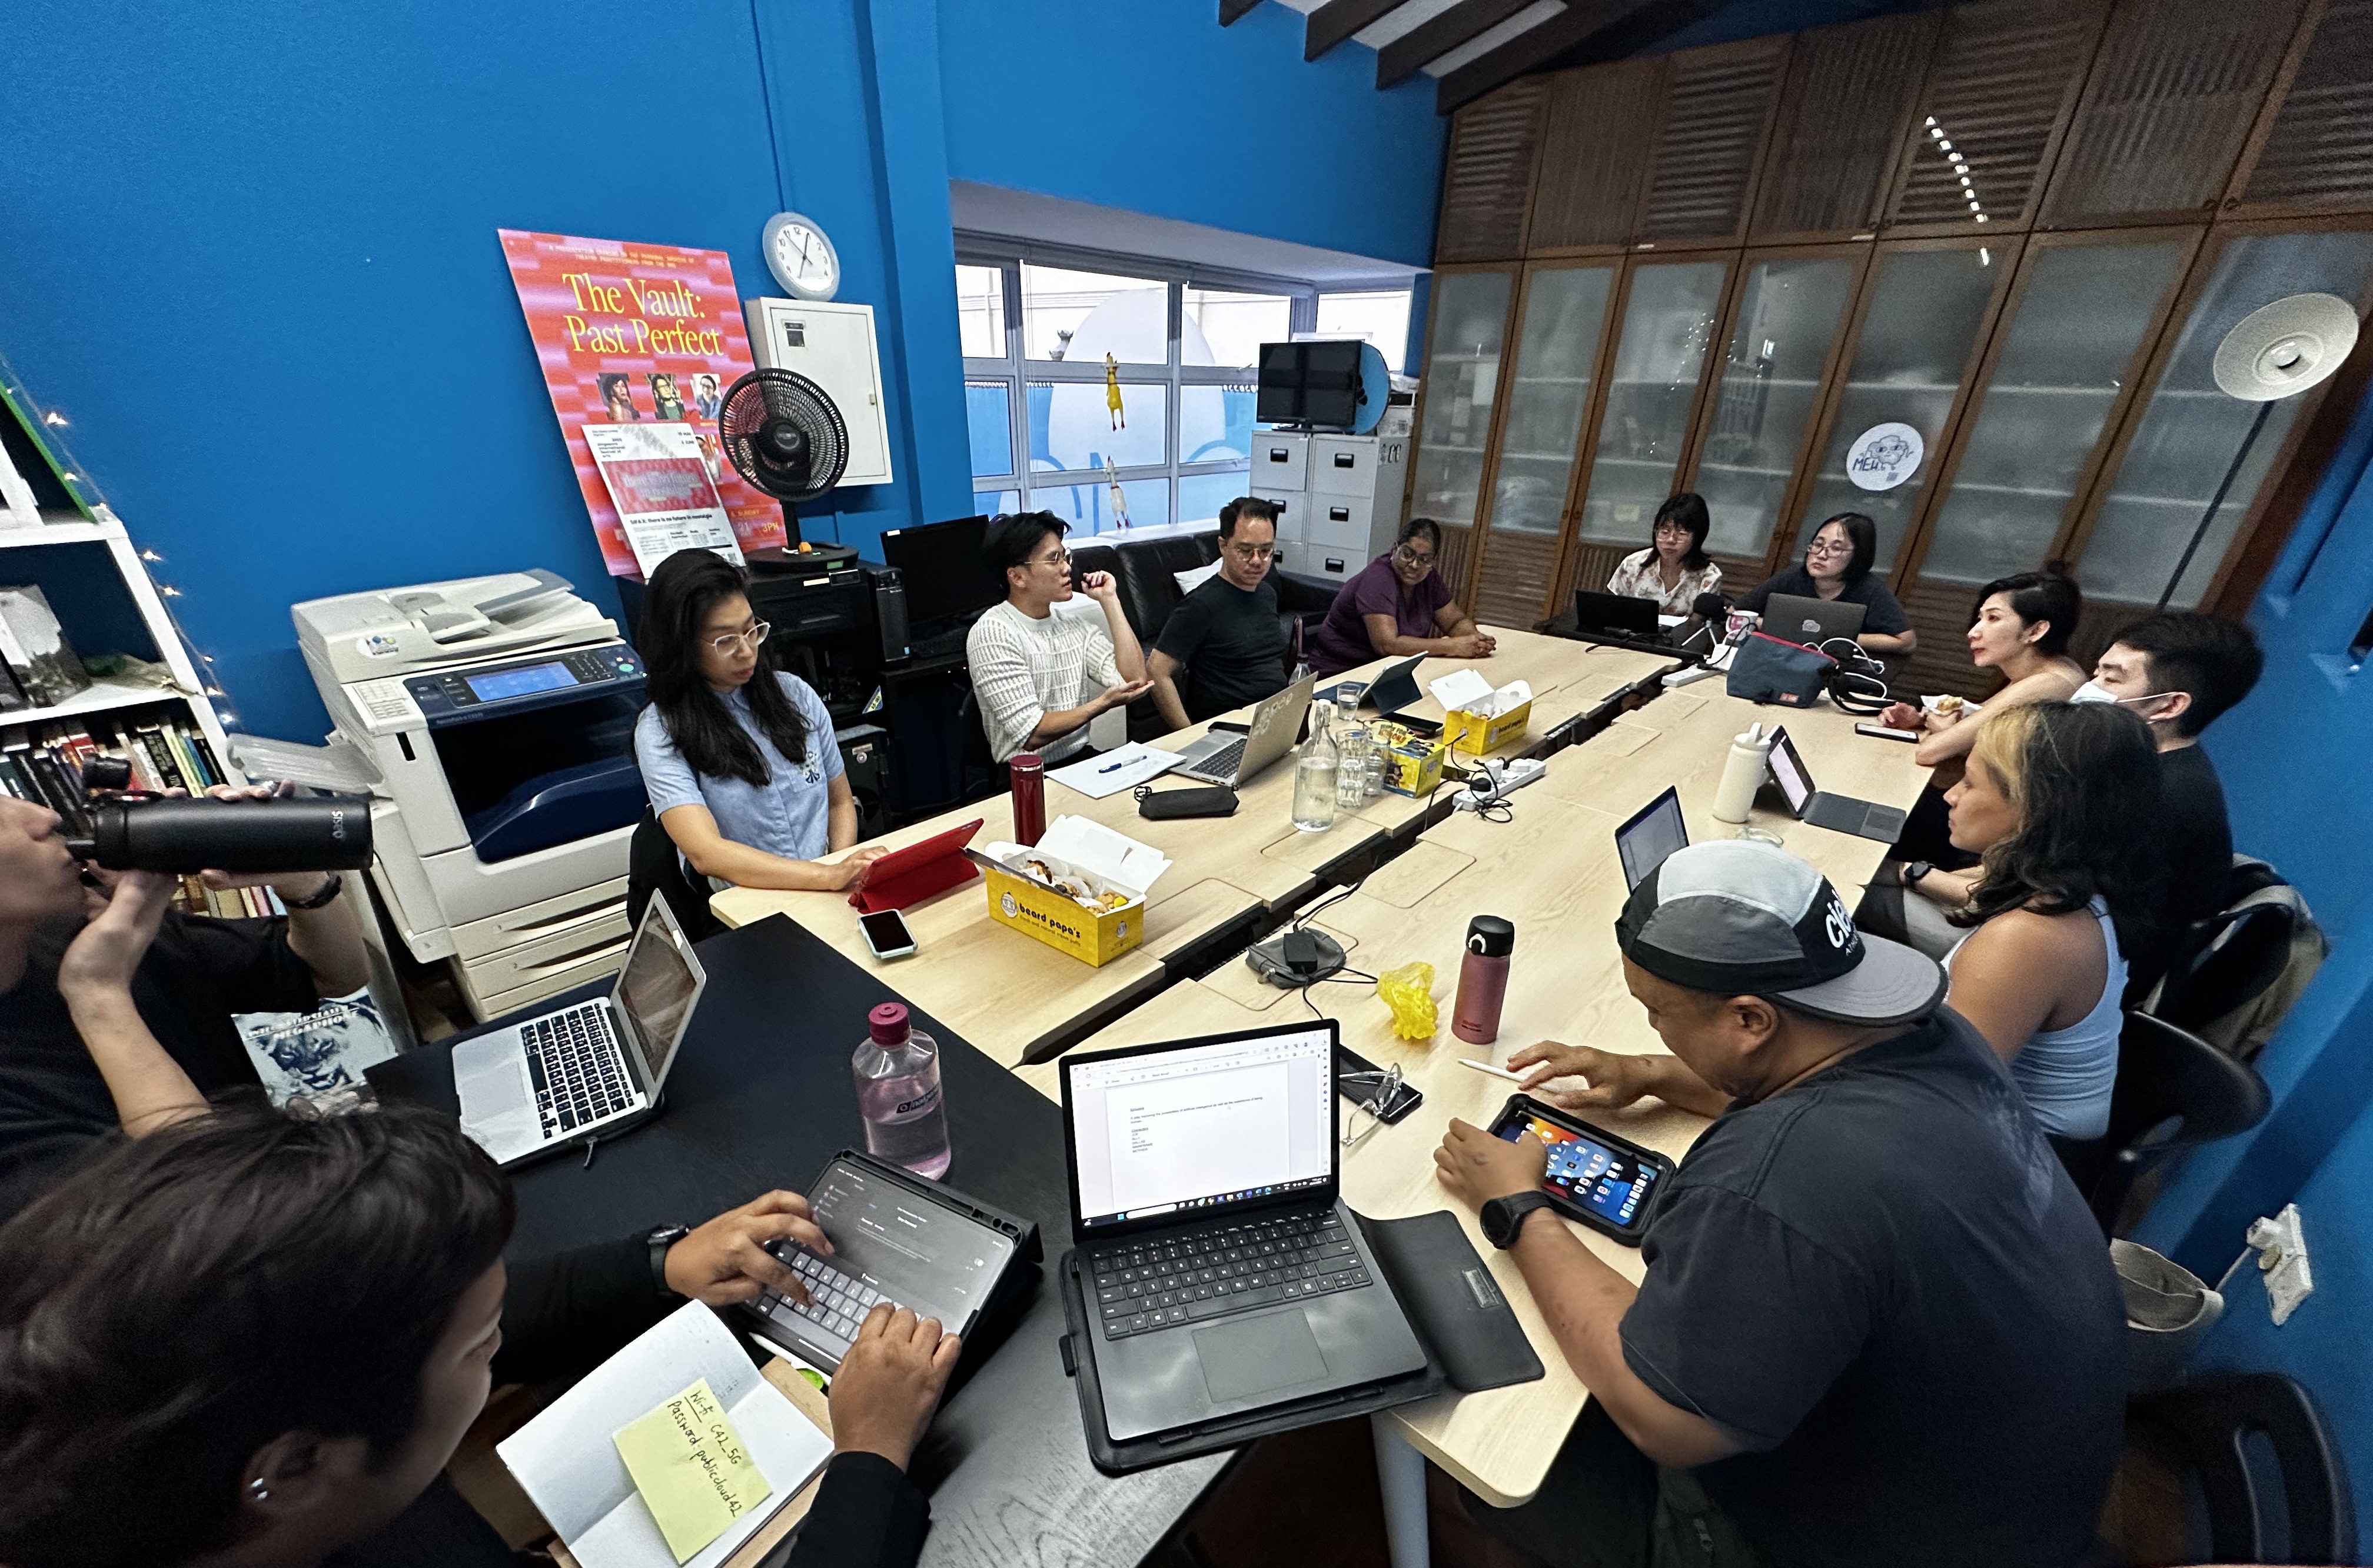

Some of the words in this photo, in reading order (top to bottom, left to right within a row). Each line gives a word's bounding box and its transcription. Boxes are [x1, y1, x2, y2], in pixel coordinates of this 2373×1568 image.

[817, 242, 822, 251] 2
[562, 273, 624, 314] The
[622, 278, 706, 318] Vault:
[563, 315, 630, 354] Past
[629, 318, 724, 357] Perfect
[761, 521, 779, 533] 3PM
[1019, 903, 1046, 923] beard
[1049, 919, 1081, 938] papa's
[710, 1424, 742, 1465] C42_5G
[689, 1449, 743, 1518] publiccloud42
